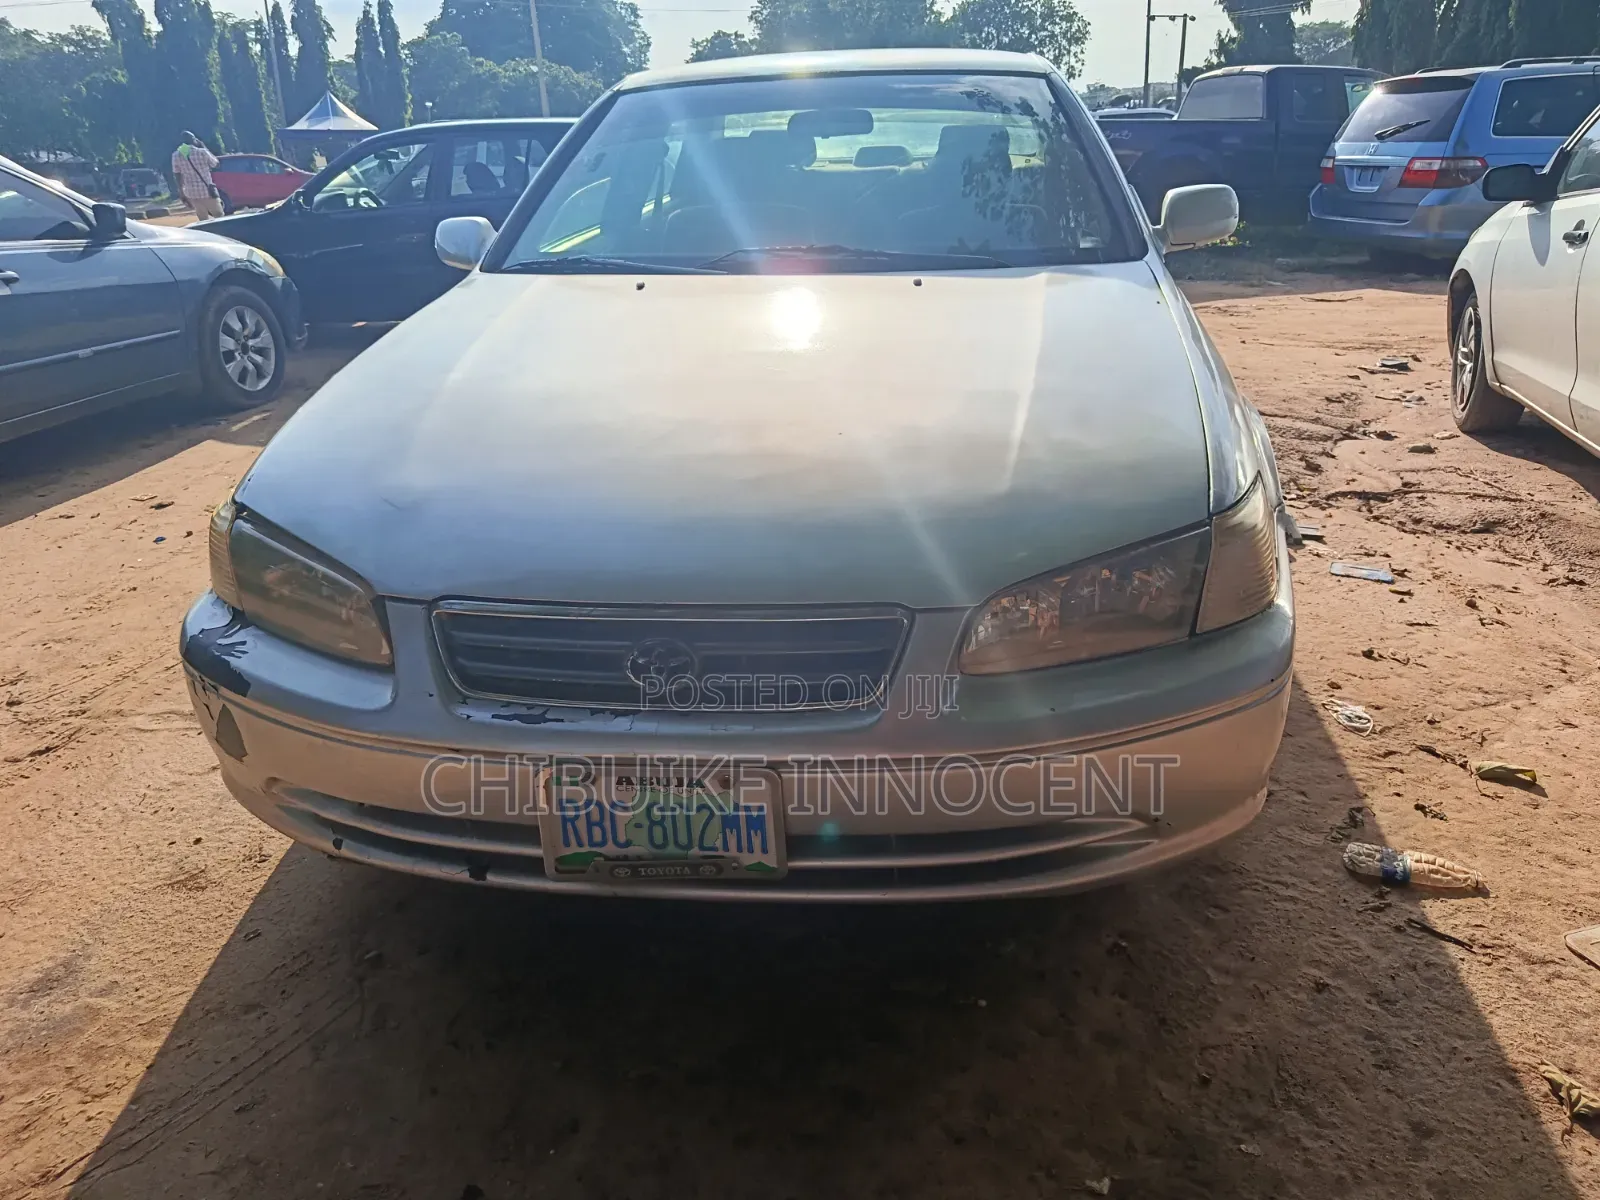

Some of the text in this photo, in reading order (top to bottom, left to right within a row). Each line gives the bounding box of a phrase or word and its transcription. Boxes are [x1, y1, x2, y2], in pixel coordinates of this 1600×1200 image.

[615, 776, 706, 788] ABUJA
[558, 799, 769, 855] RBC-802MM
[638, 866, 691, 876] TOYOTA
